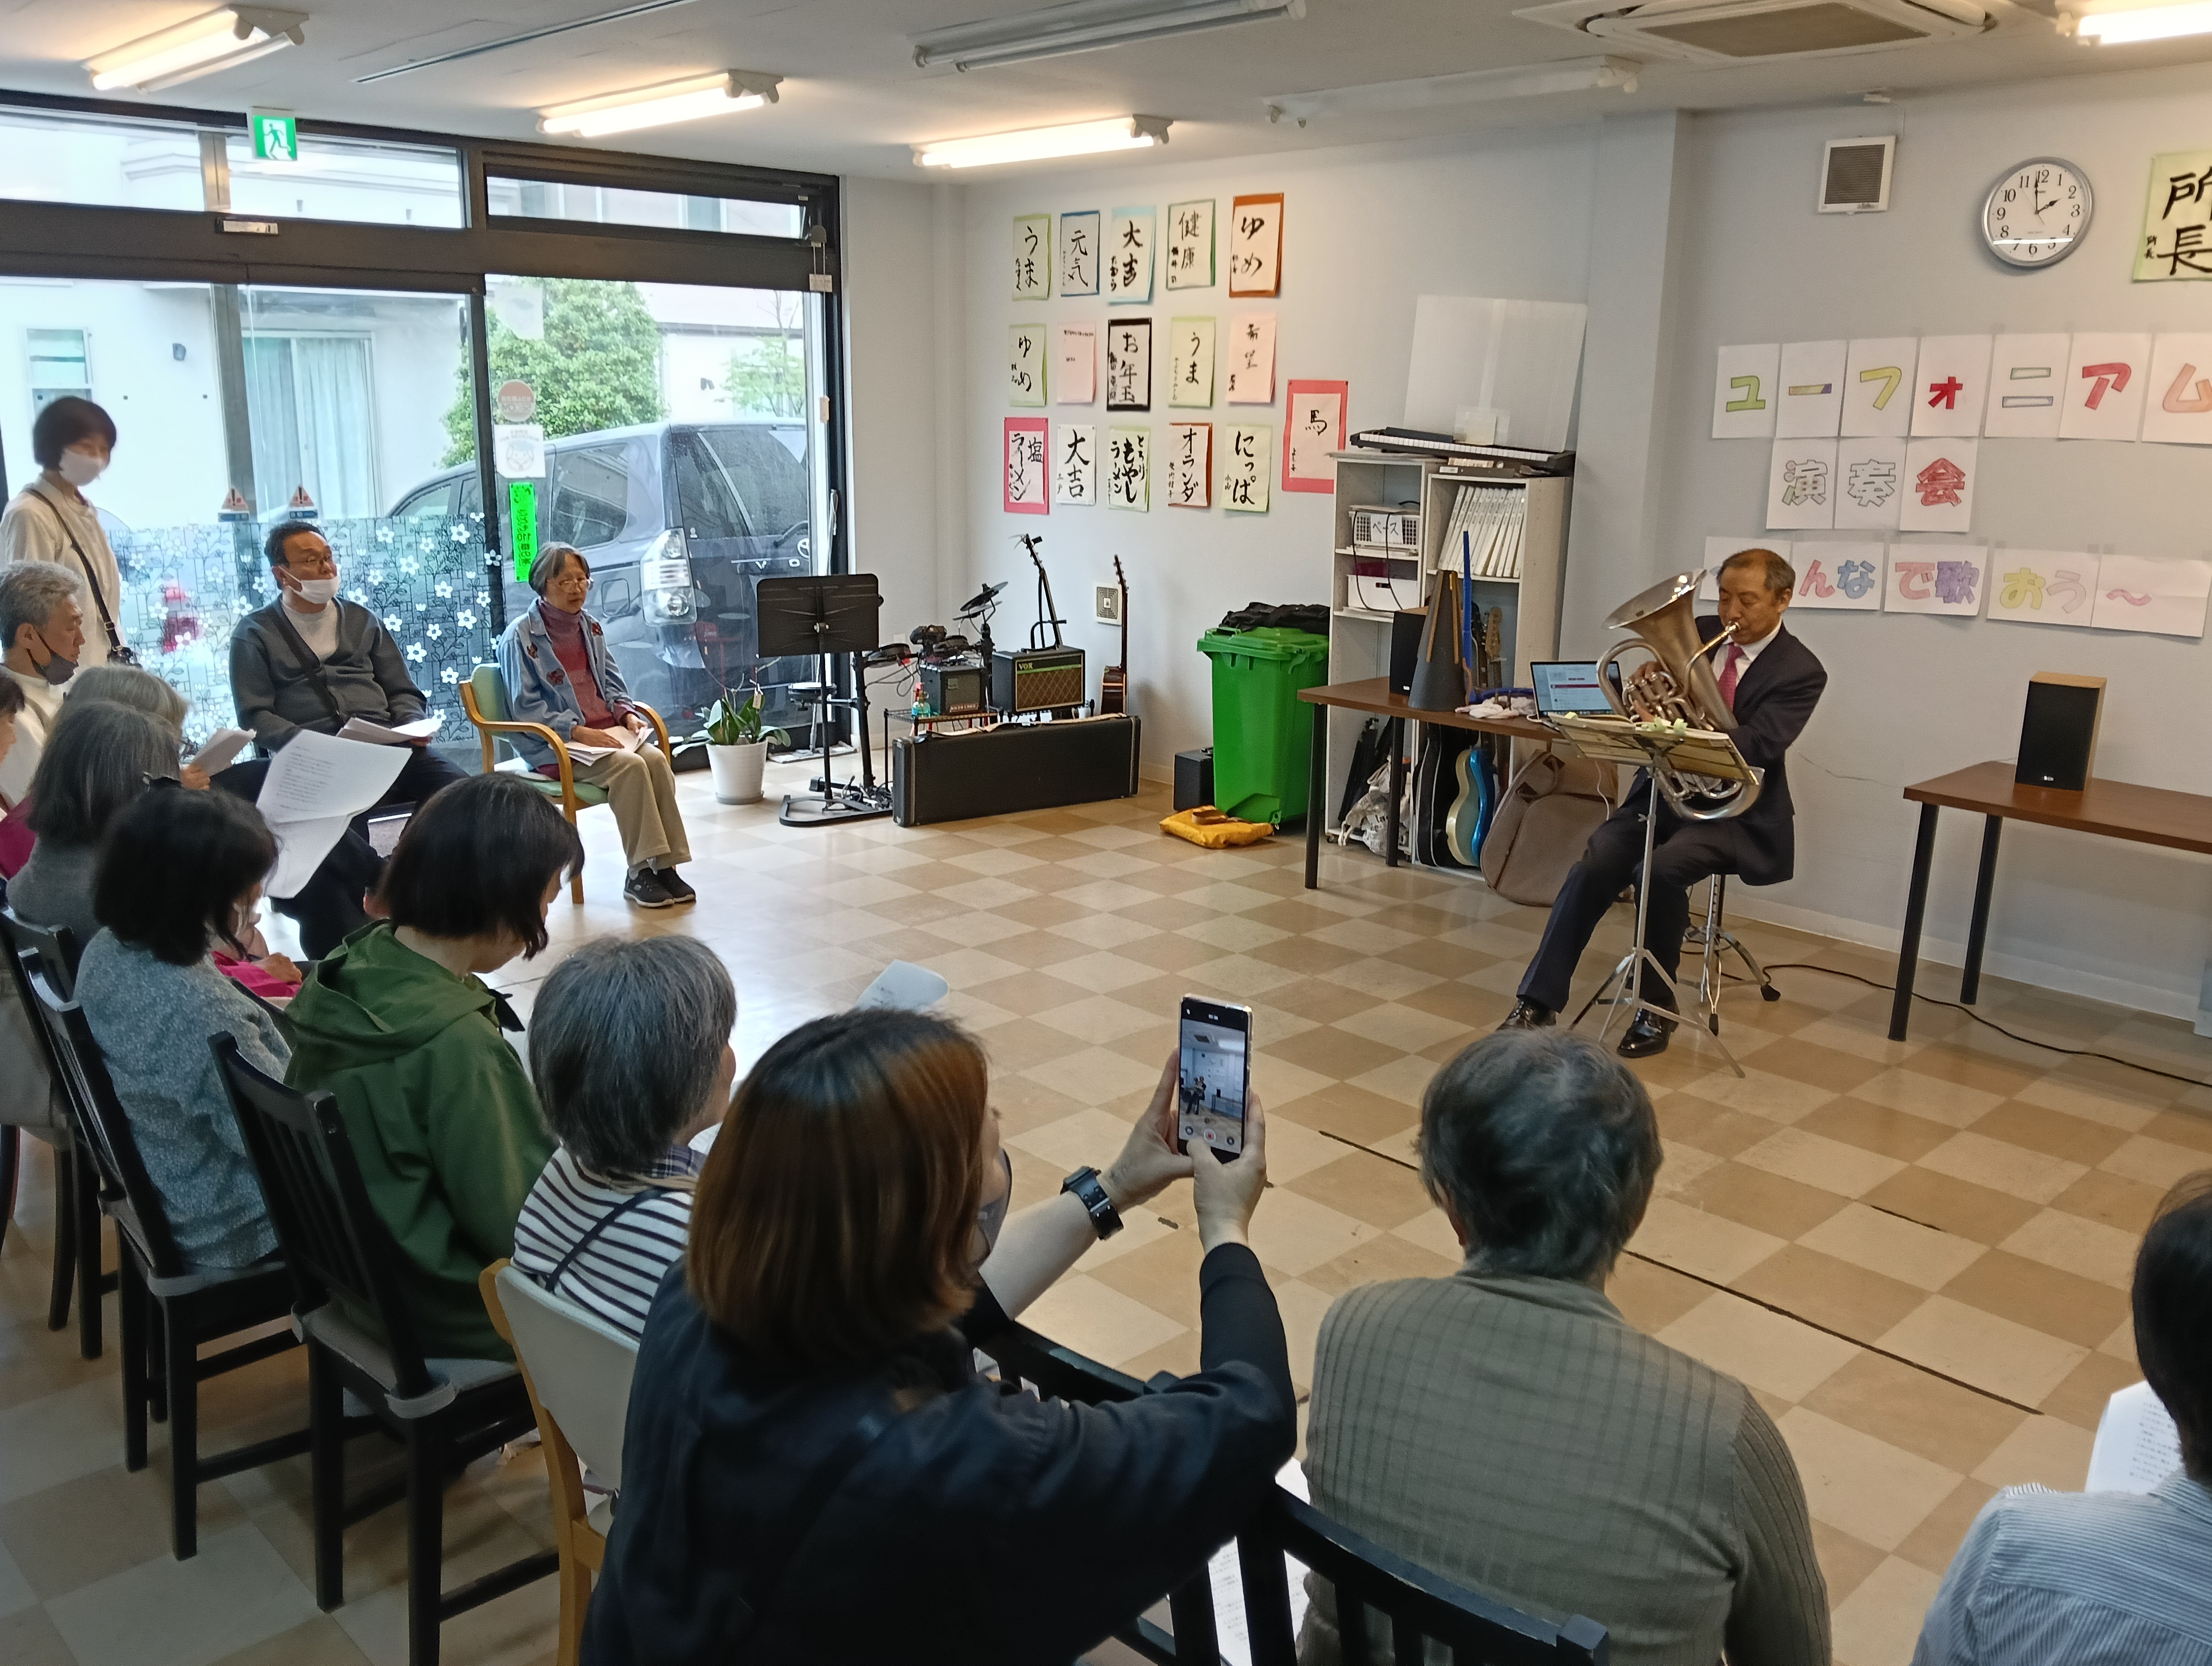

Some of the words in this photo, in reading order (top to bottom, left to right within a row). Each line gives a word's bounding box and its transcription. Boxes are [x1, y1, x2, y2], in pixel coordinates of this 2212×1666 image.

[2019, 175, 2029, 188] 11
[2037, 170, 2049, 183] 12
[2058, 173, 2062, 186] 1
[2004, 188, 2016, 202] 10
[2068, 185, 2077, 199] 2
[1997, 207, 2006, 220] 9
[2070, 204, 2080, 217] 3
[1178, 209, 1202, 270] 健康
[2000, 225, 2009, 238] 8
[2062, 223, 2070, 235] 4
[1068, 230, 1088, 287] 元気
[1240, 216, 1265, 278] ゆめ
[2028, 243, 2037, 254] 6
[1118, 332, 1139, 403] お年玉
[1186, 331, 1200, 385] うま
[1726, 362, 2212, 414] ユーフォニアム
[1305, 409, 1327, 435] 馬
[1027, 437, 1043, 463] 塩
[1064, 428, 1090, 498] 大吉
[1121, 437, 1139, 503] もやし
[1181, 427, 1198, 502] オランダ
[1782, 457, 1967, 508] 演奏会
[1018, 662, 1033, 670] VOX
